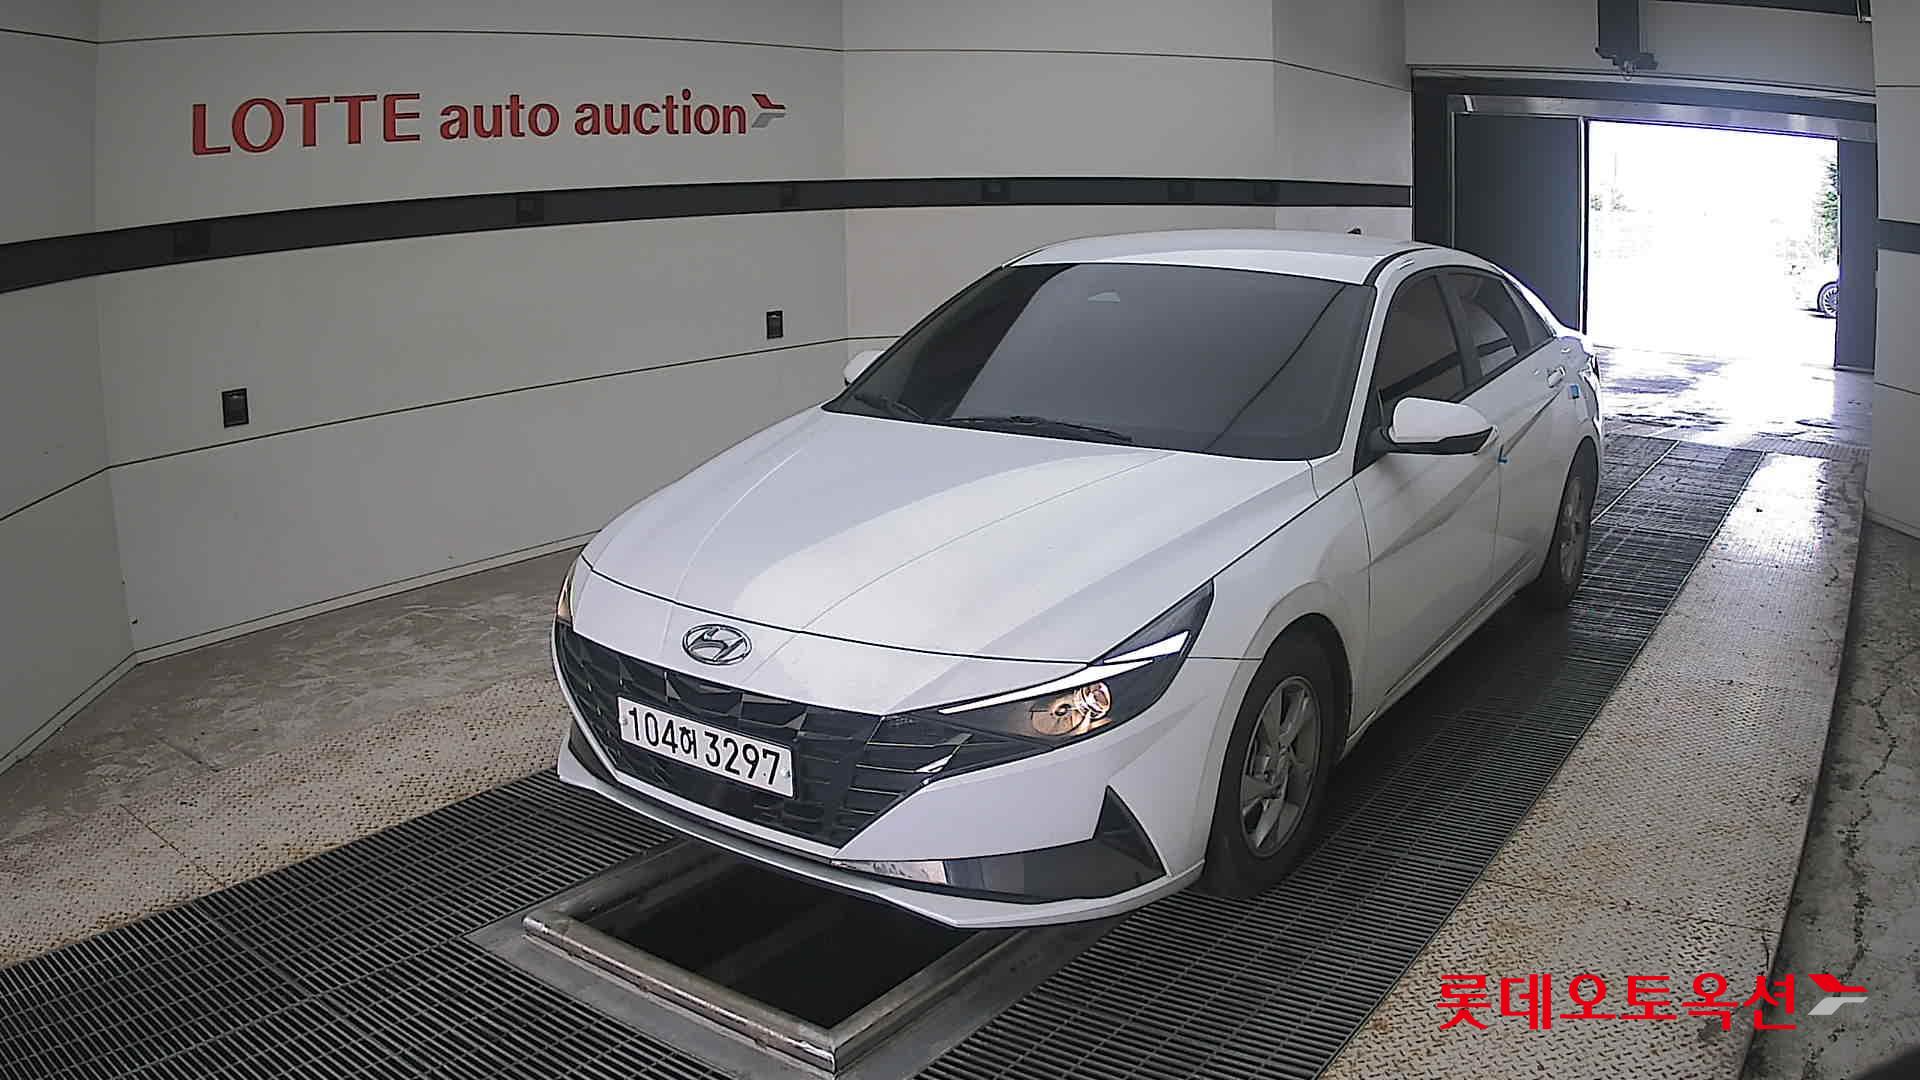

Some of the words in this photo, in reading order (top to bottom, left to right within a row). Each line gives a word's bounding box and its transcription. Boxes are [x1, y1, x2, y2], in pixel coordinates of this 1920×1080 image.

[191, 92, 421, 157] LOTTE
[438, 94, 561, 140] auto
[574, 88, 748, 137] auction
[628, 706, 698, 760] 104허
[703, 730, 781, 786] 3297
